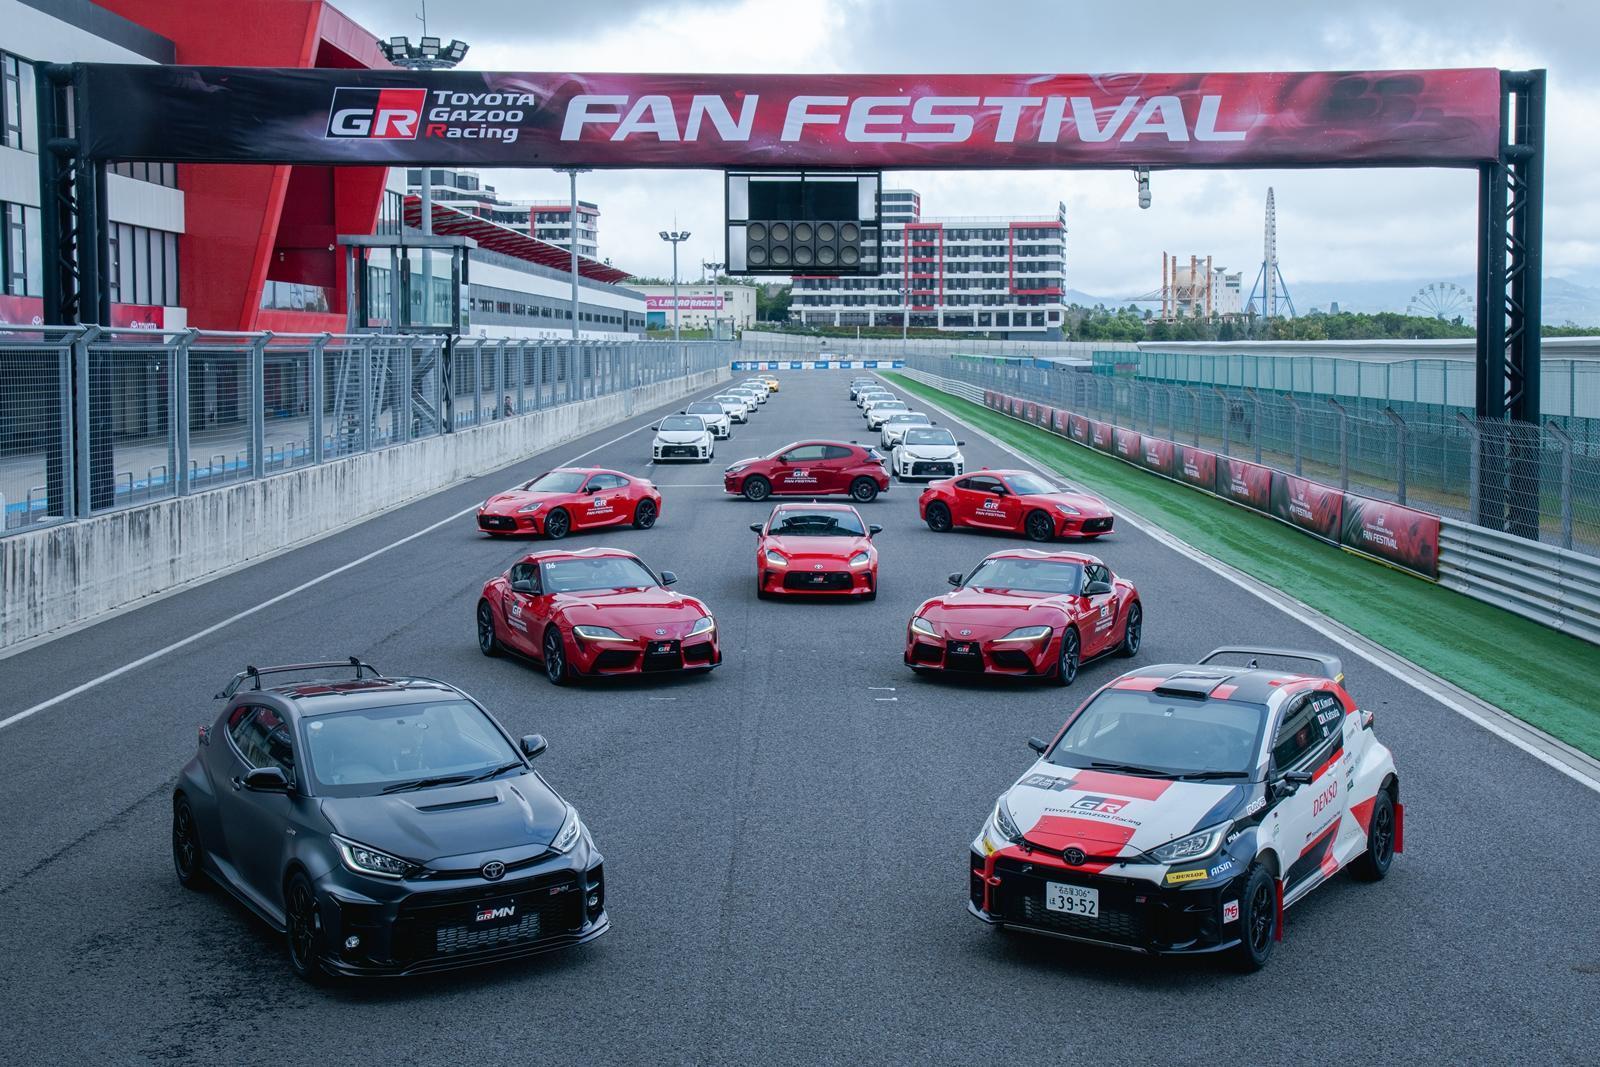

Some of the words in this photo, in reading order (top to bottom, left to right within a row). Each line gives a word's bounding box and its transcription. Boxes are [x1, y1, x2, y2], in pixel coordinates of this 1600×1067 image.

[433, 90, 535, 106] TOYOTA
[330, 108, 418, 136] GR
[429, 107, 524, 122] GAZOO
[560, 94, 759, 142] FAN
[780, 95, 1247, 143] FESTIVAL
[425, 124, 519, 143] Racing
[1363, 530, 1372, 541] FAN
[1373, 533, 1398, 550] FESTIVAL
[1073, 800, 1122, 814] GR
[1313, 780, 1338, 818] DENSO
[1111, 815, 1142, 826] Racing
[1175, 872, 1204, 880] DUNLOP
[1074, 888, 1088, 898] 306
[1058, 895, 1095, 915] 39-52
[476, 906, 515, 922] GRMN
